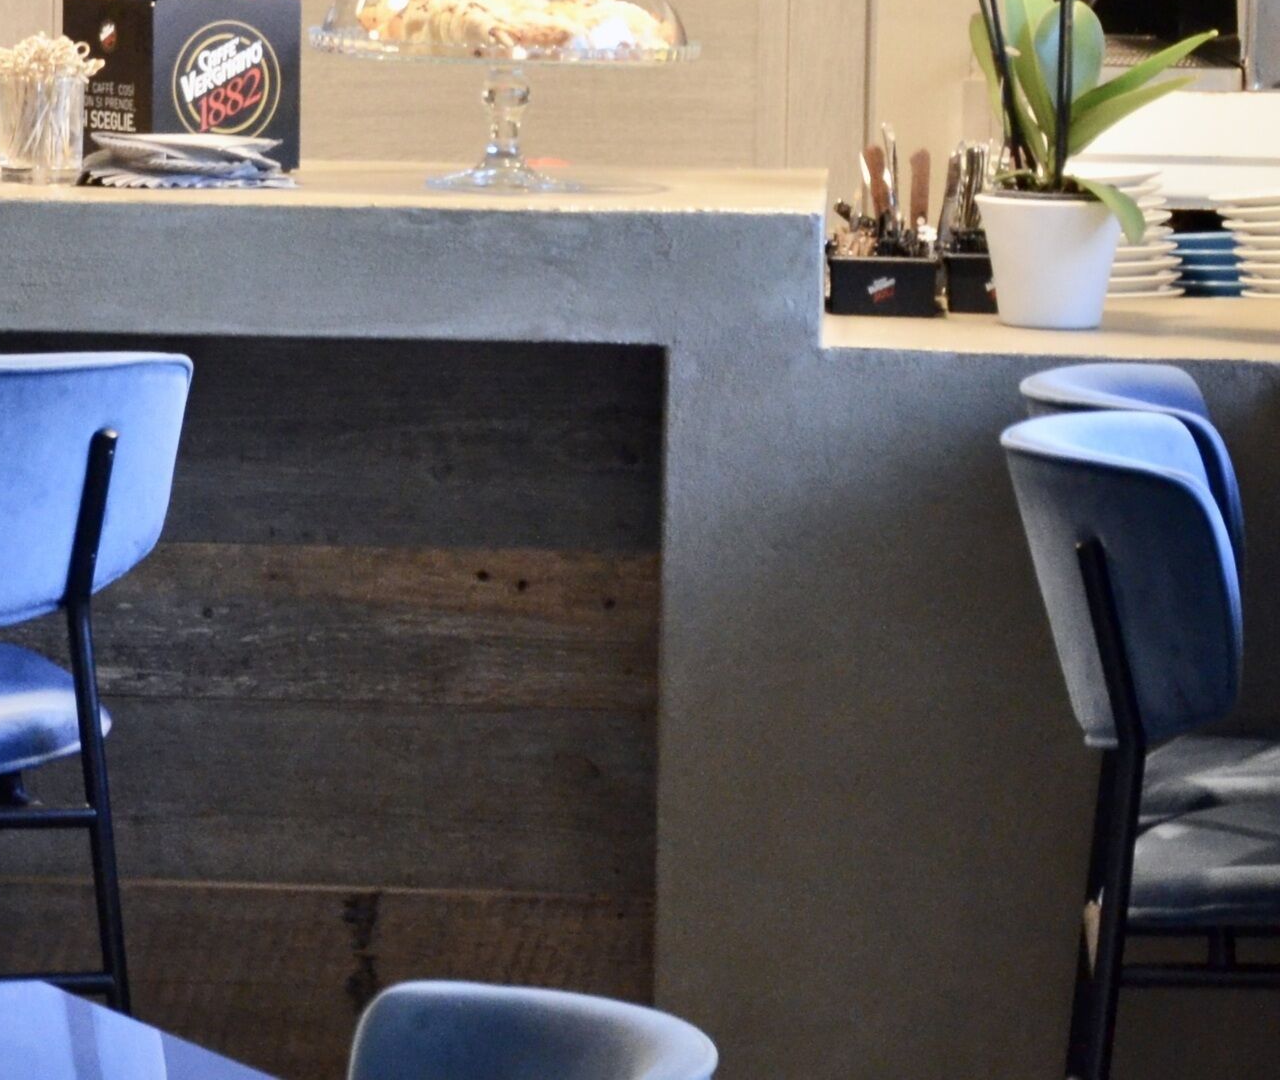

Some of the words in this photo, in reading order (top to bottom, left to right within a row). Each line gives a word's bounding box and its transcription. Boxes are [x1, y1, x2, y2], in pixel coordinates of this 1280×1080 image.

[179, 39, 264, 103] VERGNANO
[197, 67, 263, 133] 1882
[90, 110, 137, 132] SCEGLIE.
